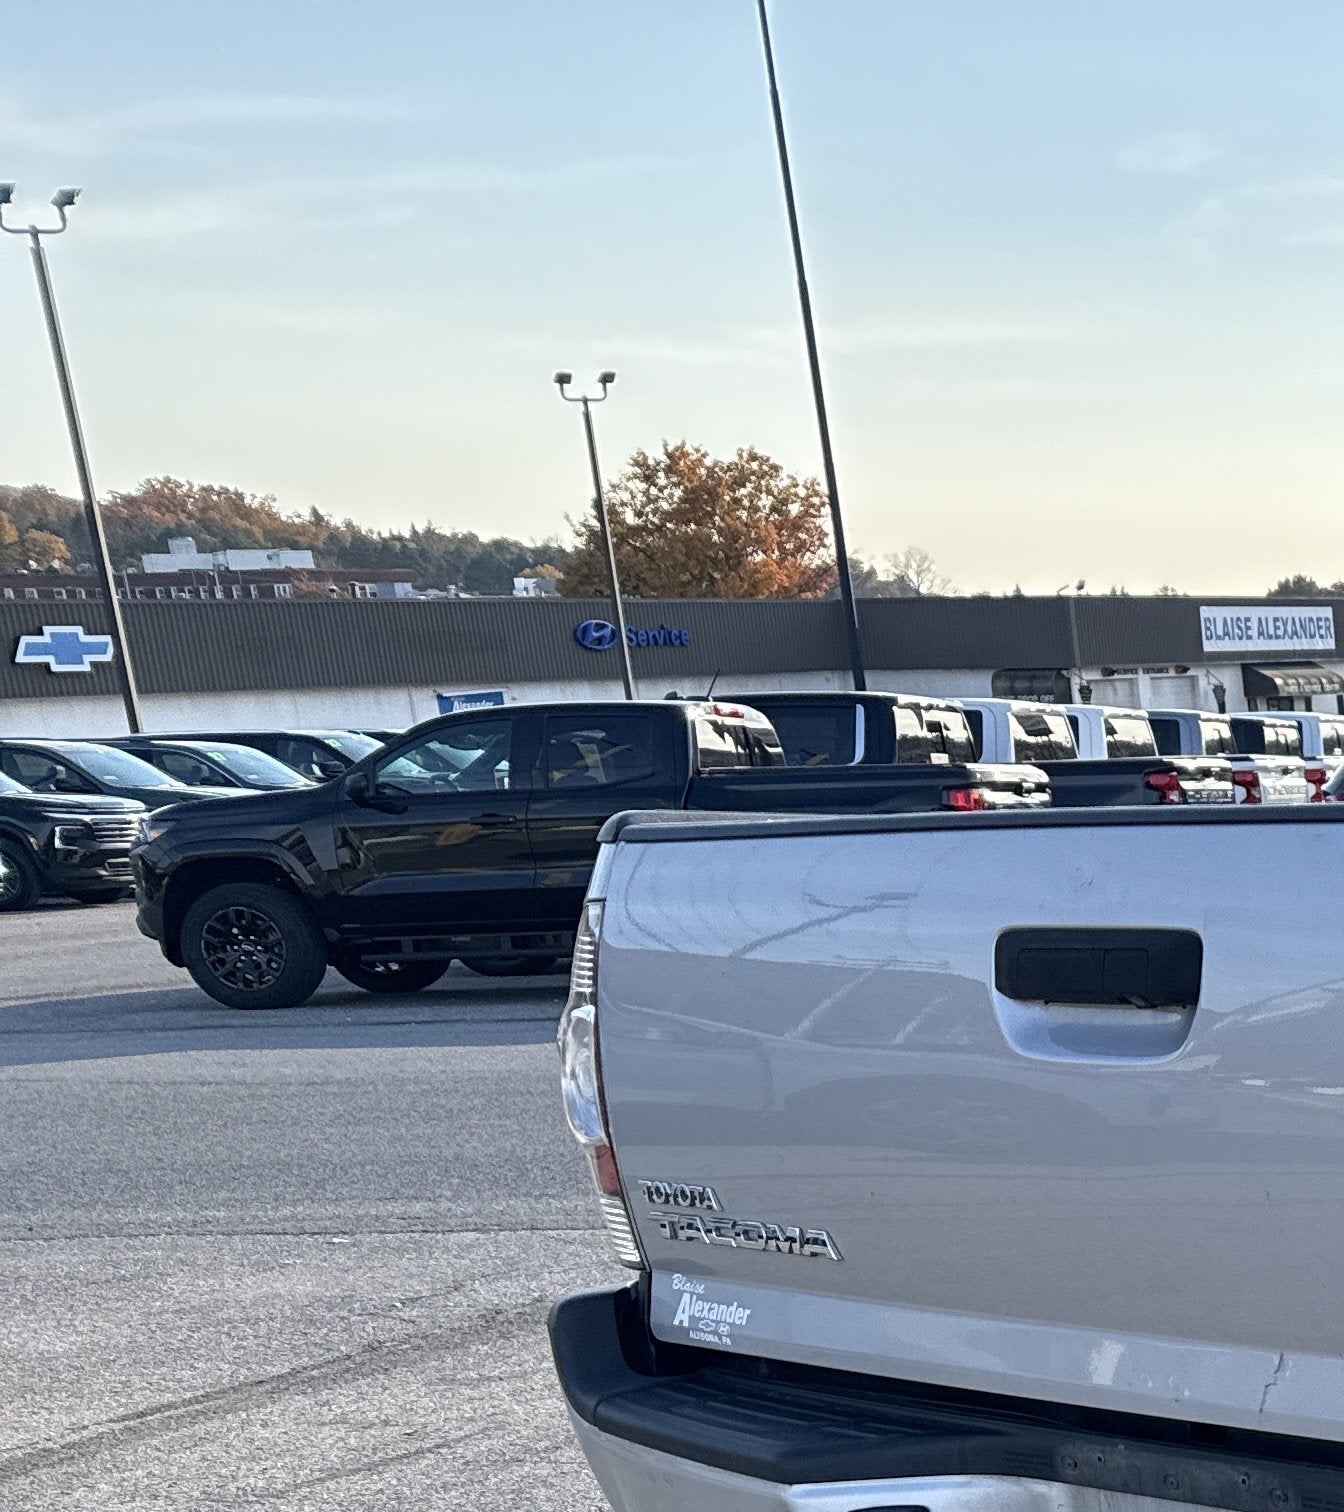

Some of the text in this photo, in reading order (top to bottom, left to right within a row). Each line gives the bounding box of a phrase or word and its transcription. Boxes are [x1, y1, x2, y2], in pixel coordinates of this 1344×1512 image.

[625, 625, 690, 647] Service
[1203, 616, 1334, 641] BLAISE ALEXANDER
[638, 1180, 724, 1212] TOYOTA
[648, 1211, 844, 1261] TACOMA
[672, 1273, 706, 1295] Blaise
[672, 1292, 751, 1327] Alexander
